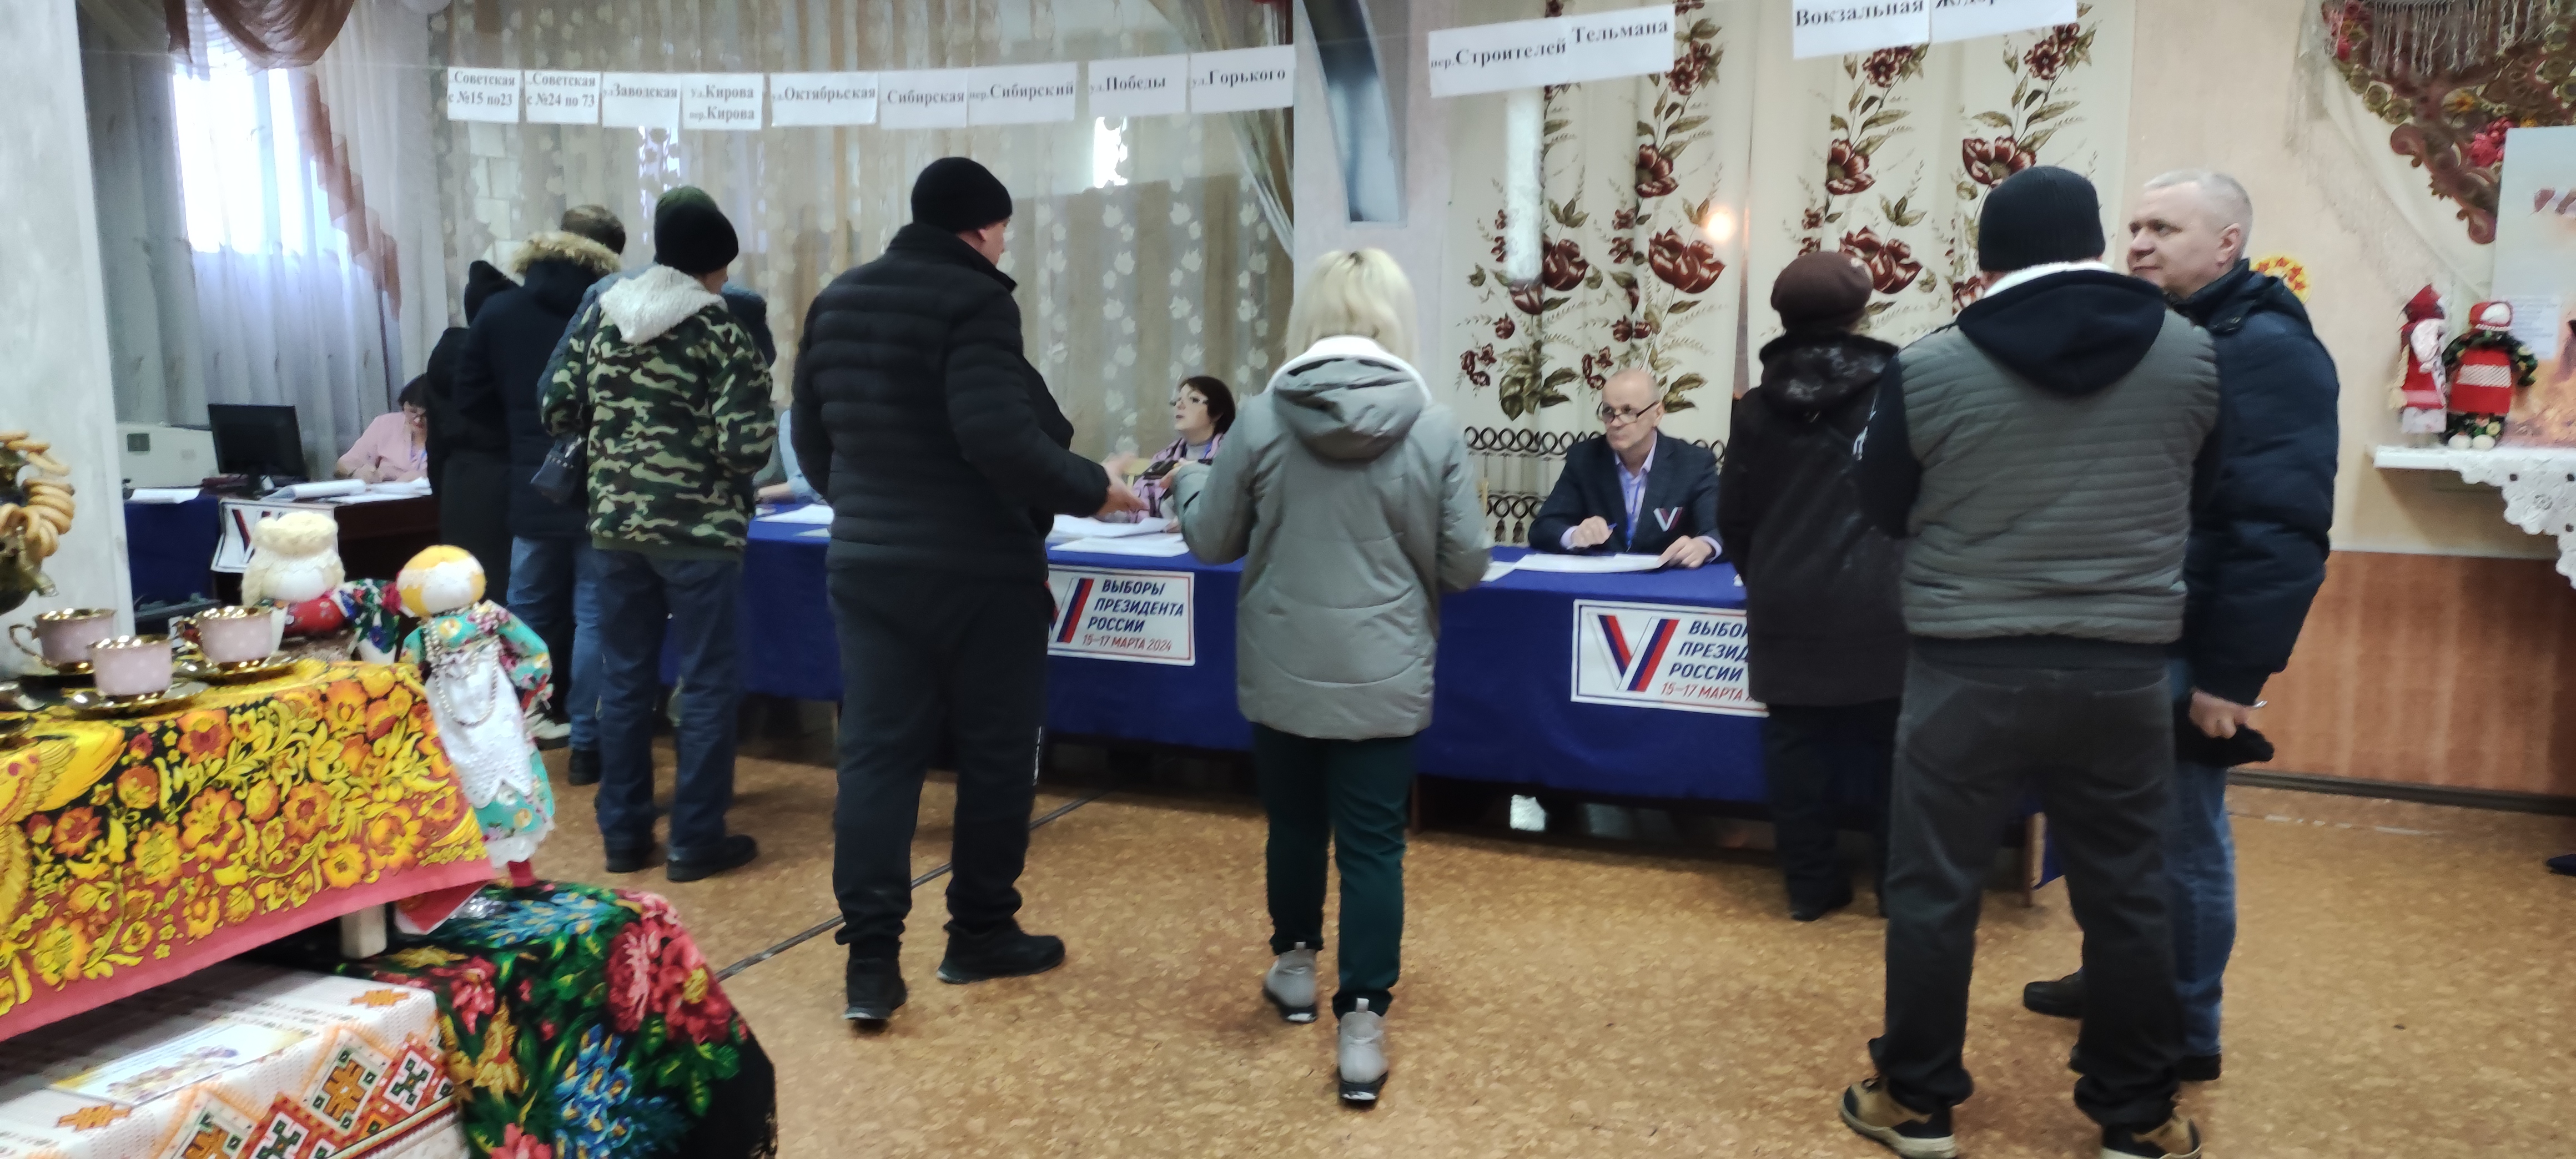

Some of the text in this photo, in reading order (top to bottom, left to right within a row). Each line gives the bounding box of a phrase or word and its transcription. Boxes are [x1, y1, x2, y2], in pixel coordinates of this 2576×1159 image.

[1796, 0, 1923, 26] Вокзальная
[1571, 20, 1668, 44] Тельмана
[1430, 38, 1566, 69] пер.Строителей
[565, 97, 578, 107] по
[582, 93, 595, 107] 73
[1101, 579, 1166, 596] ВЫБОРЫ
[1094, 598, 1185, 617] ПРЕЗИДЕНТА
[1088, 616, 1145, 633] РОССИИ
[1688, 620, 1748, 638] ВЫБО
[1110, 636, 1145, 651] МАРТА
[1146, 639, 1171, 652] 2024
[1668, 663, 1744, 682] РОССИИ
[1698, 685, 1743, 701] МАРТА
